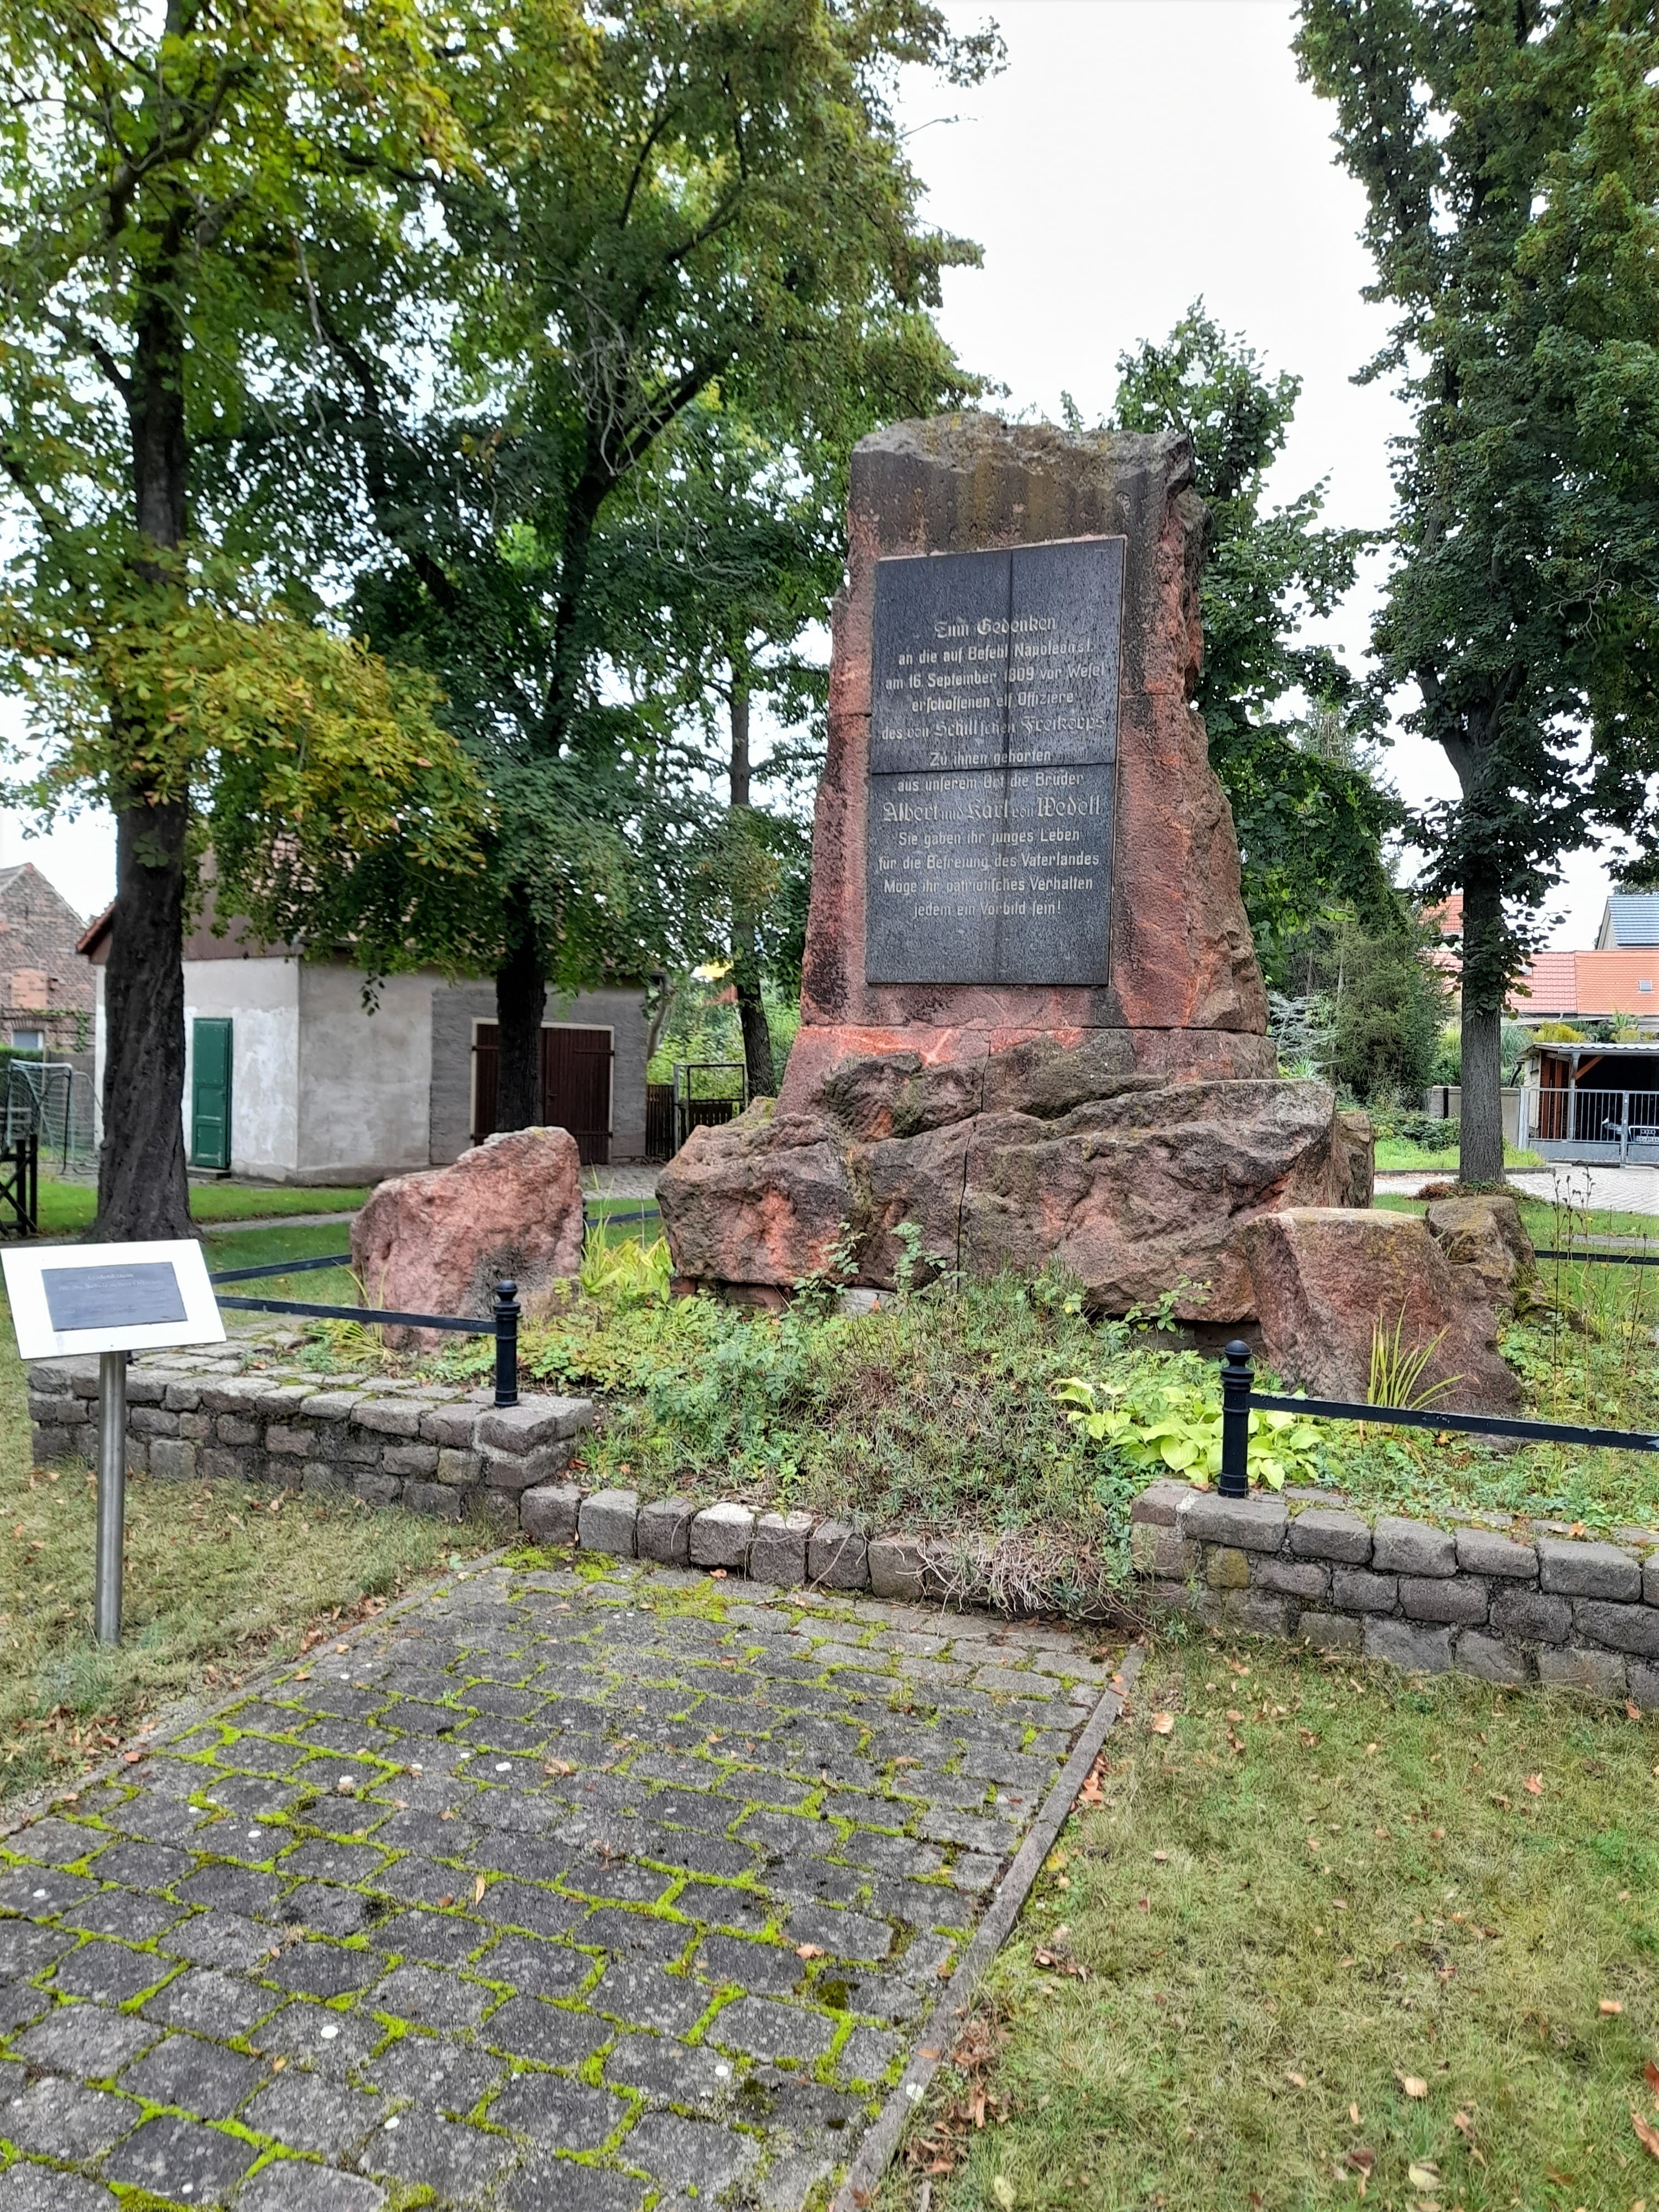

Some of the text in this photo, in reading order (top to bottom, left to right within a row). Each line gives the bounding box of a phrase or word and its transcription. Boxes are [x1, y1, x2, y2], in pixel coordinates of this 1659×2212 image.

[977, 615, 1057, 635] Gedenken
[899, 653, 913, 665] an
[919, 649, 937, 664] die
[943, 647, 963, 664] auf
[968, 643, 1008, 662] Befehl
[1014, 640, 1084, 658] Napoleons
[885, 679, 904, 690] am
[909, 673, 924, 689] 16.
[927, 669, 997, 690] September
[1004, 666, 1035, 683] 1809
[1040, 668, 1062, 680] vor
[997, 692, 1012, 709] elf
[1018, 691, 1074, 708] Offiziere
[881, 725, 903, 740] des
[906, 726, 930, 739] von
[930, 748, 1051, 767] Zu ihnen gehörten
[898, 780, 920, 792] aus
[983, 774, 1005, 789] Ort
[1010, 773, 1029, 788] die
[1035, 771, 1084, 787] Brüder
[883, 795, 1100, 822] Albert und Karl von Wedell
[899, 826, 1080, 849] Sie gaben ihr junges Leben
[878, 851, 1100, 871] für die Befreiung des Vaterlandes
[884, 878, 917, 896] Möge
[922, 879, 940, 893] ihr
[1029, 875, 1093, 891] Verhalten
[912, 902, 952, 920] jedem
[957, 904, 975, 916] ein
[980, 900, 1026, 916] Vorbild
